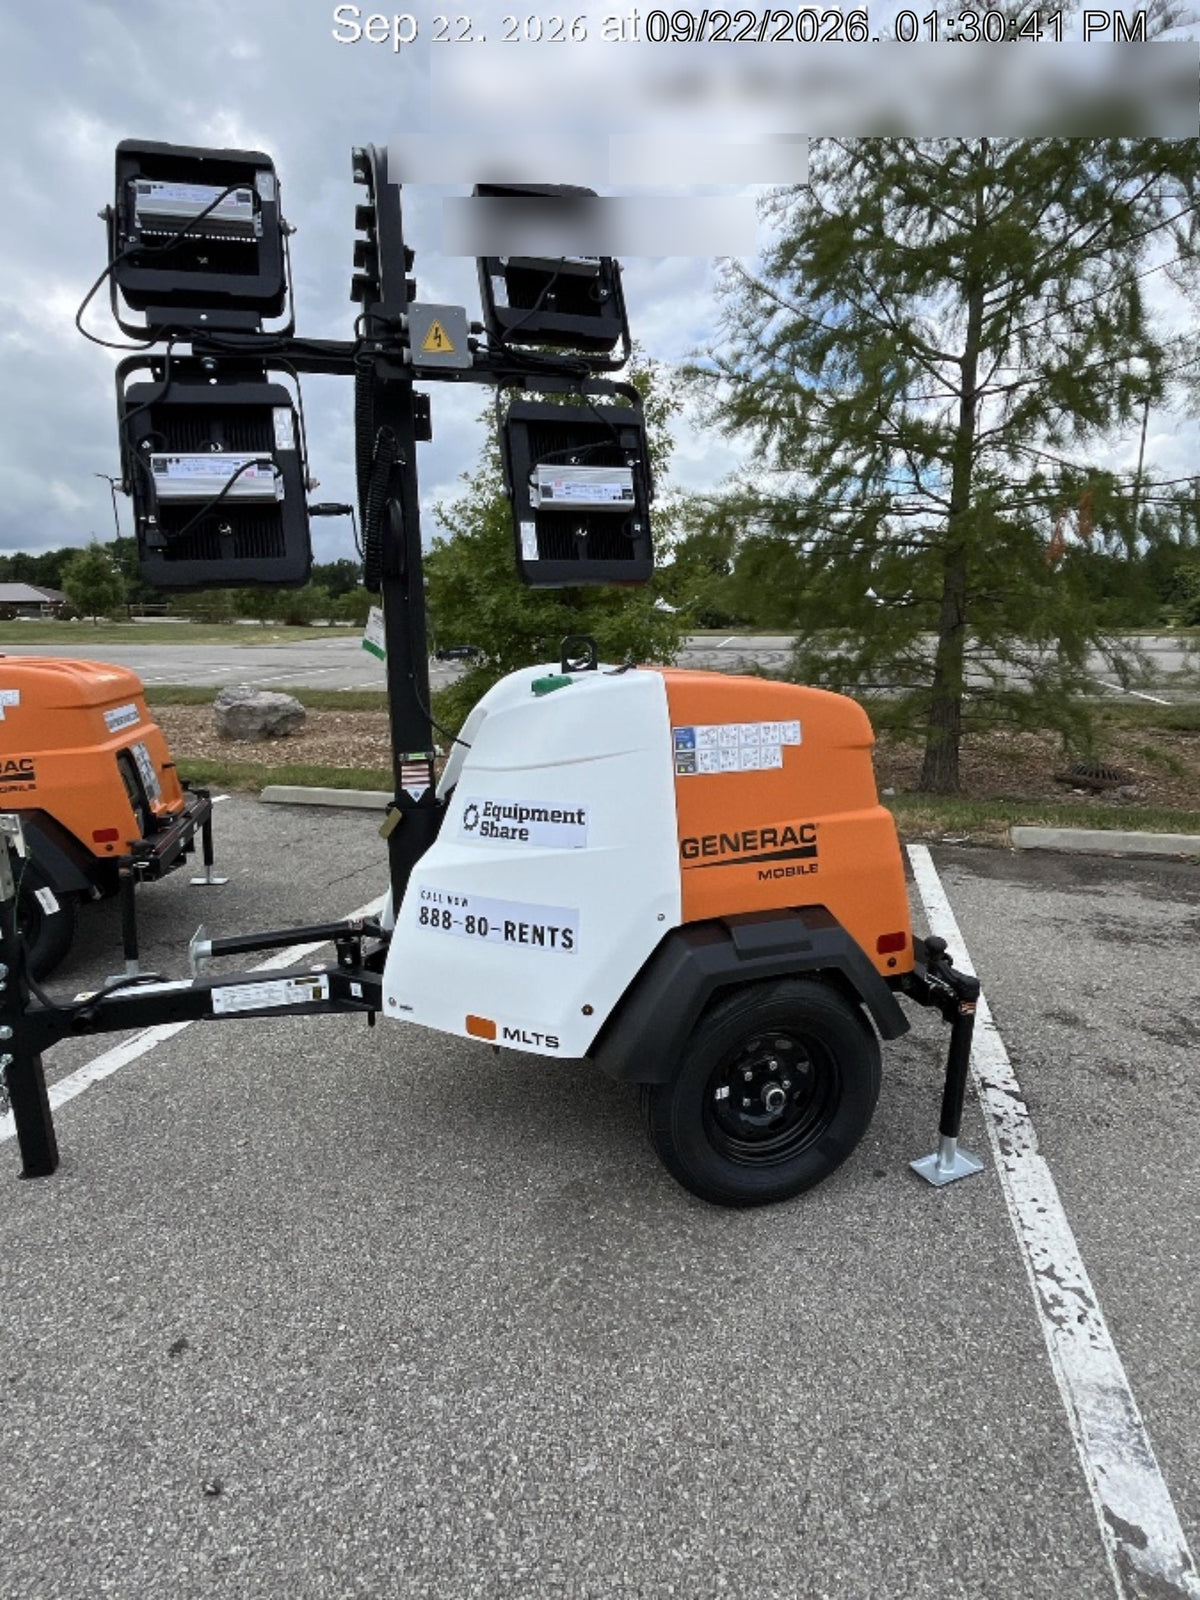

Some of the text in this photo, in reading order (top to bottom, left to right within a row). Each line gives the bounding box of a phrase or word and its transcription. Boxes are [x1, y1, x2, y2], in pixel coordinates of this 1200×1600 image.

[482, 801, 586, 826] Equipment
[479, 820, 529, 841] Share
[681, 823, 817, 859] GENERAC
[758, 863, 819, 880] MOBILE
[420, 889, 443, 904] CALL
[418, 905, 575, 950] 888-80-RENTS
[502, 1026, 560, 1049] MLTS
